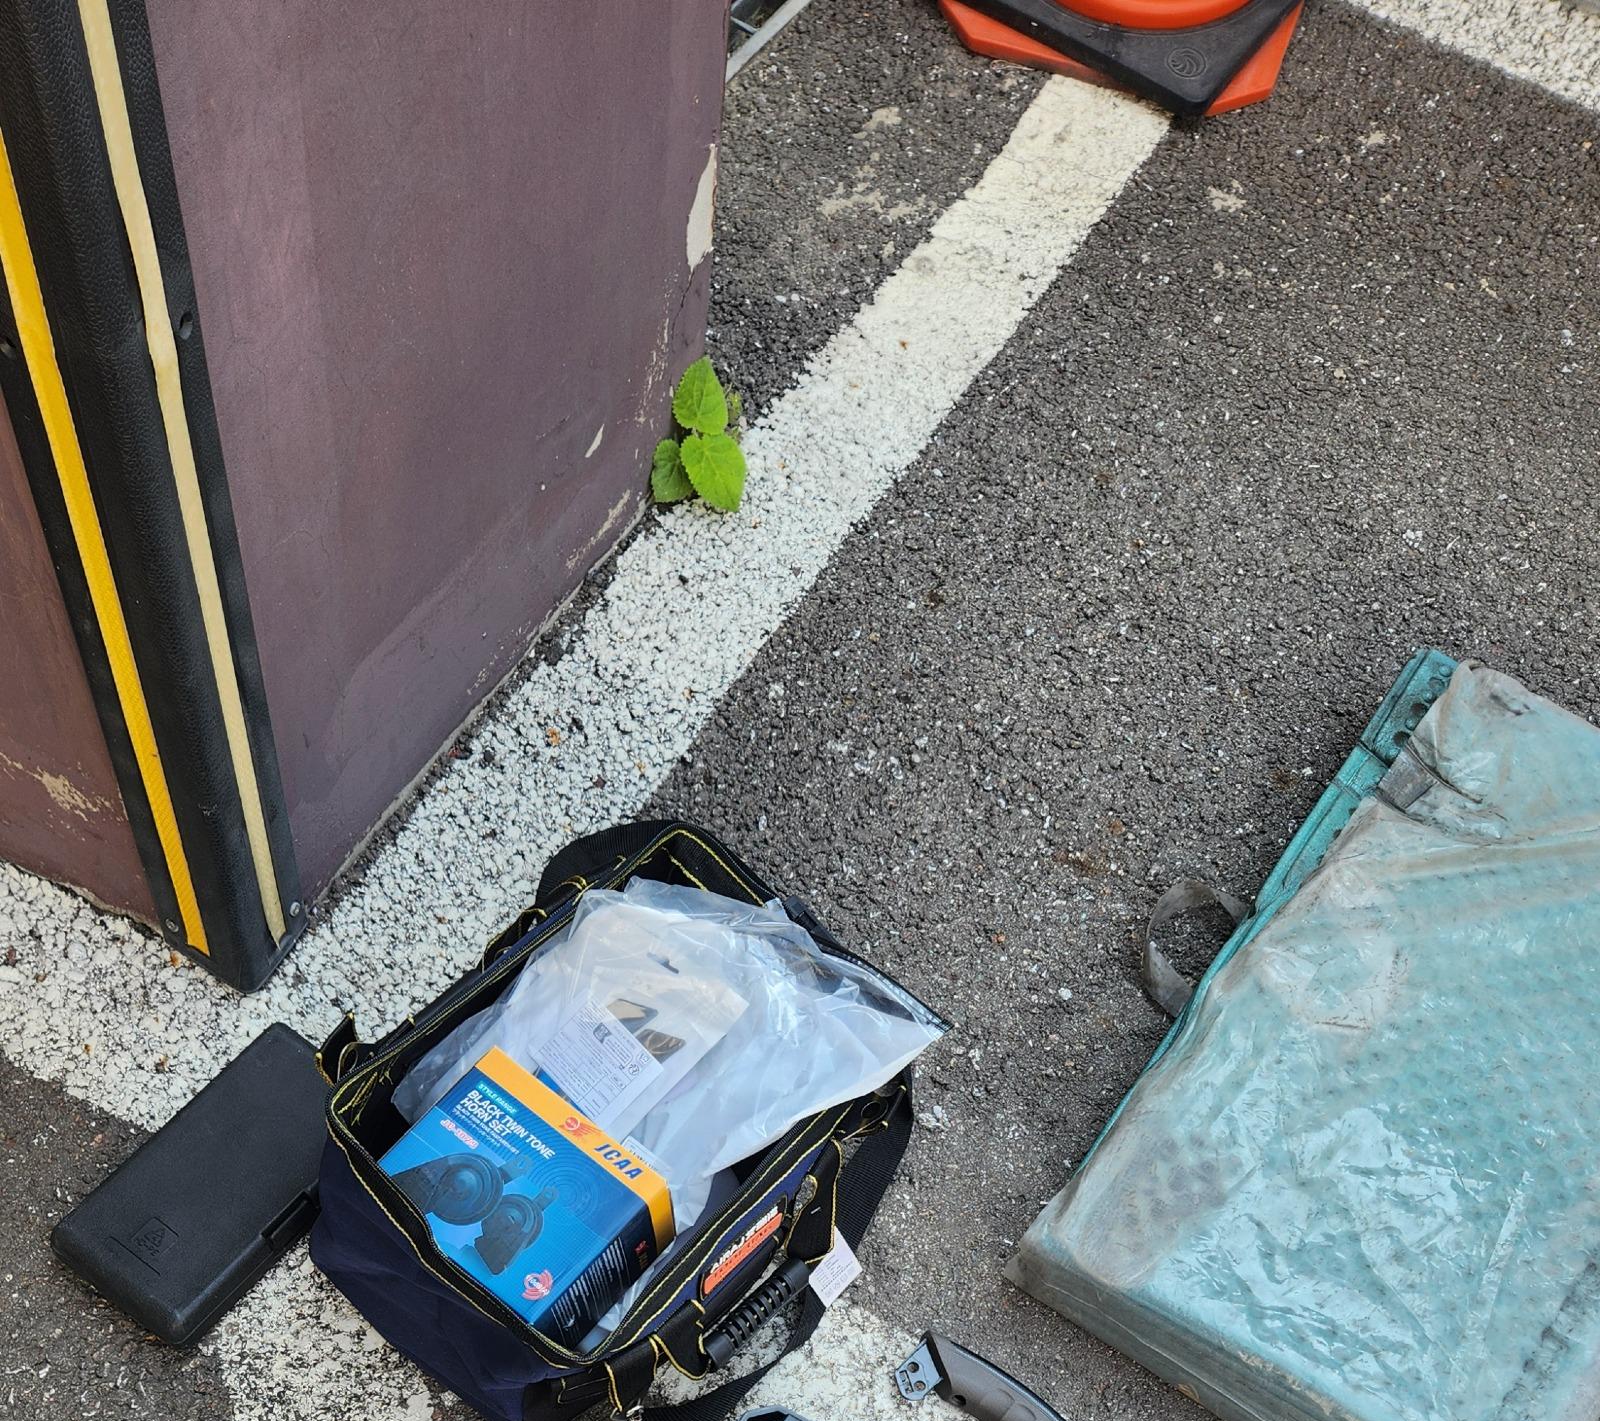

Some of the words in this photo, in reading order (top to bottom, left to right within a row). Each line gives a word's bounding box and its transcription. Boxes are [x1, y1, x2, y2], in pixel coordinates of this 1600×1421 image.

[459, 1097, 493, 1122] HORN
[489, 1119, 512, 1137] SET
[478, 1083, 497, 1100] STYLE
[495, 1096, 518, 1114] RANGE
[467, 1090, 505, 1119] BLACK
[501, 1115, 529, 1138] TWIN
[525, 1134, 556, 1160] TONE
[594, 1143, 643, 1179] JCAA
